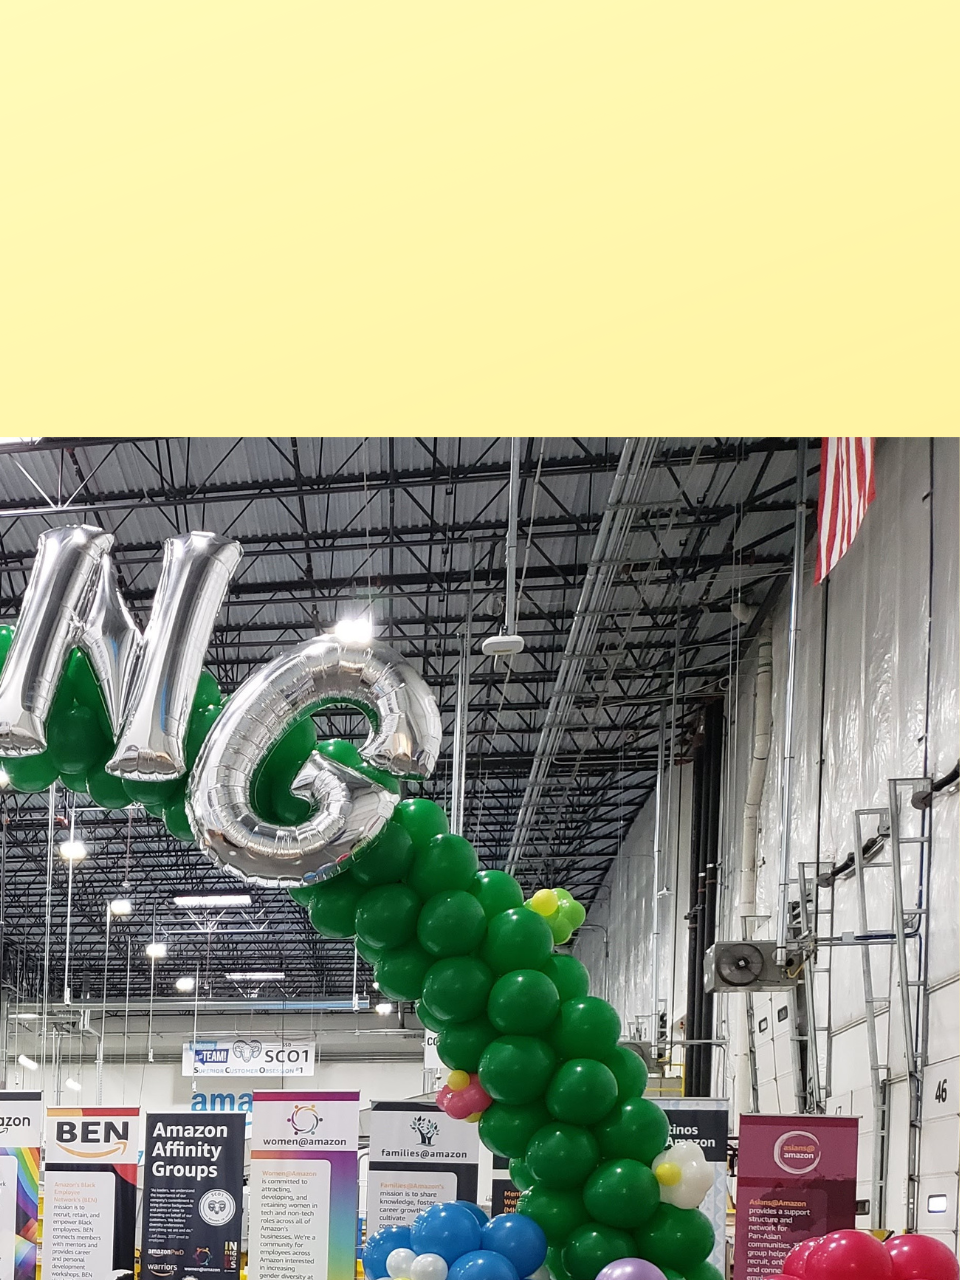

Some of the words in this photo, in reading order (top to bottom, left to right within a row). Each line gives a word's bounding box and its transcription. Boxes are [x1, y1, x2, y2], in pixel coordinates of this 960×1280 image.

[203, 1051, 227, 1062] TEAM!
[264, 1049, 309, 1063] SCO1
[935, 1079, 948, 1103] 46
[191, 1092, 253, 1112] ama
[56, 1121, 129, 1143] BEN
[152, 1122, 228, 1138] Amazon
[669, 1124, 698, 1134] tinos
[263, 1138, 347, 1147] women@amazon
[152, 1141, 222, 1161] Affinity
[381, 1149, 467, 1159] families@amazon
[152, 1161, 218, 1181] Groups
